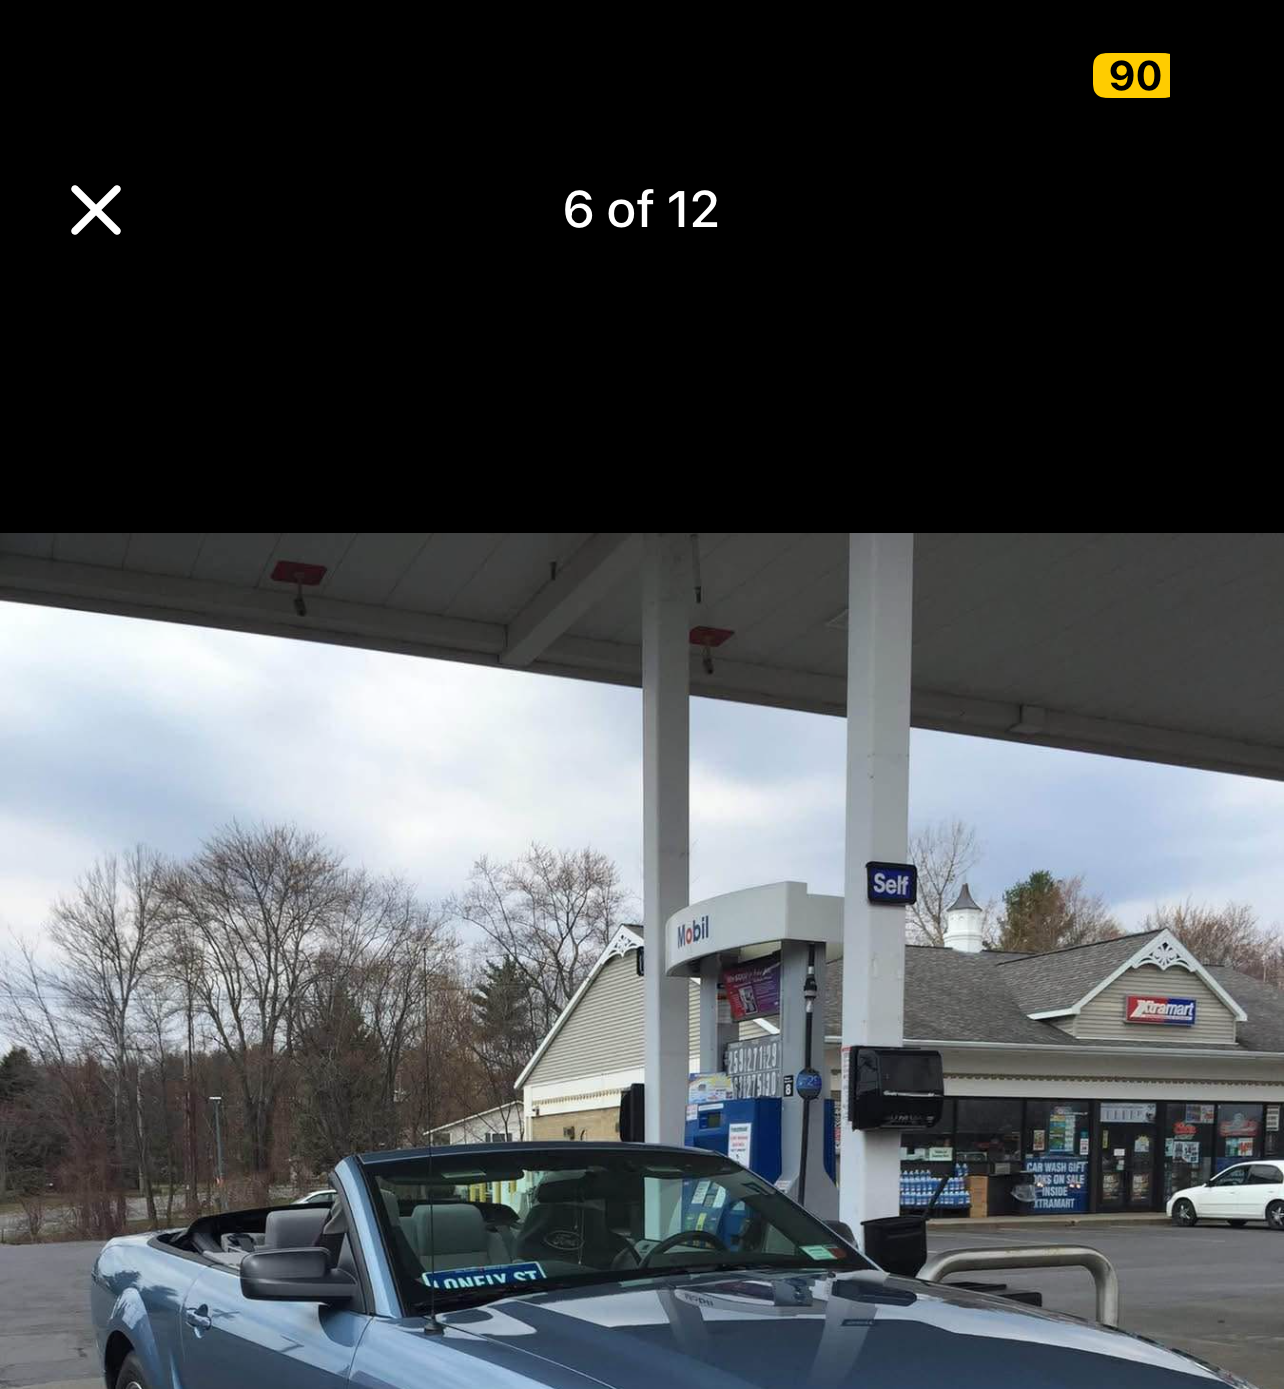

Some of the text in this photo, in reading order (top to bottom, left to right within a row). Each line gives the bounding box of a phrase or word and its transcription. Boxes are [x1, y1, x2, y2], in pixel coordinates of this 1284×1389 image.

[873, 872, 909, 896] Self
[677, 915, 709, 949] Mobil
[1129, 999, 1194, 1018] Xtramart
[785, 1083, 792, 1096] 8
[1026, 1162, 1086, 1173] CAR WASH GIFT
[1053, 1174, 1065, 1185] ON
[1066, 1174, 1085, 1184] SALE
[1042, 1186, 1068, 1197] INSIDE
[1034, 1198, 1075, 1208] XTRAMART
